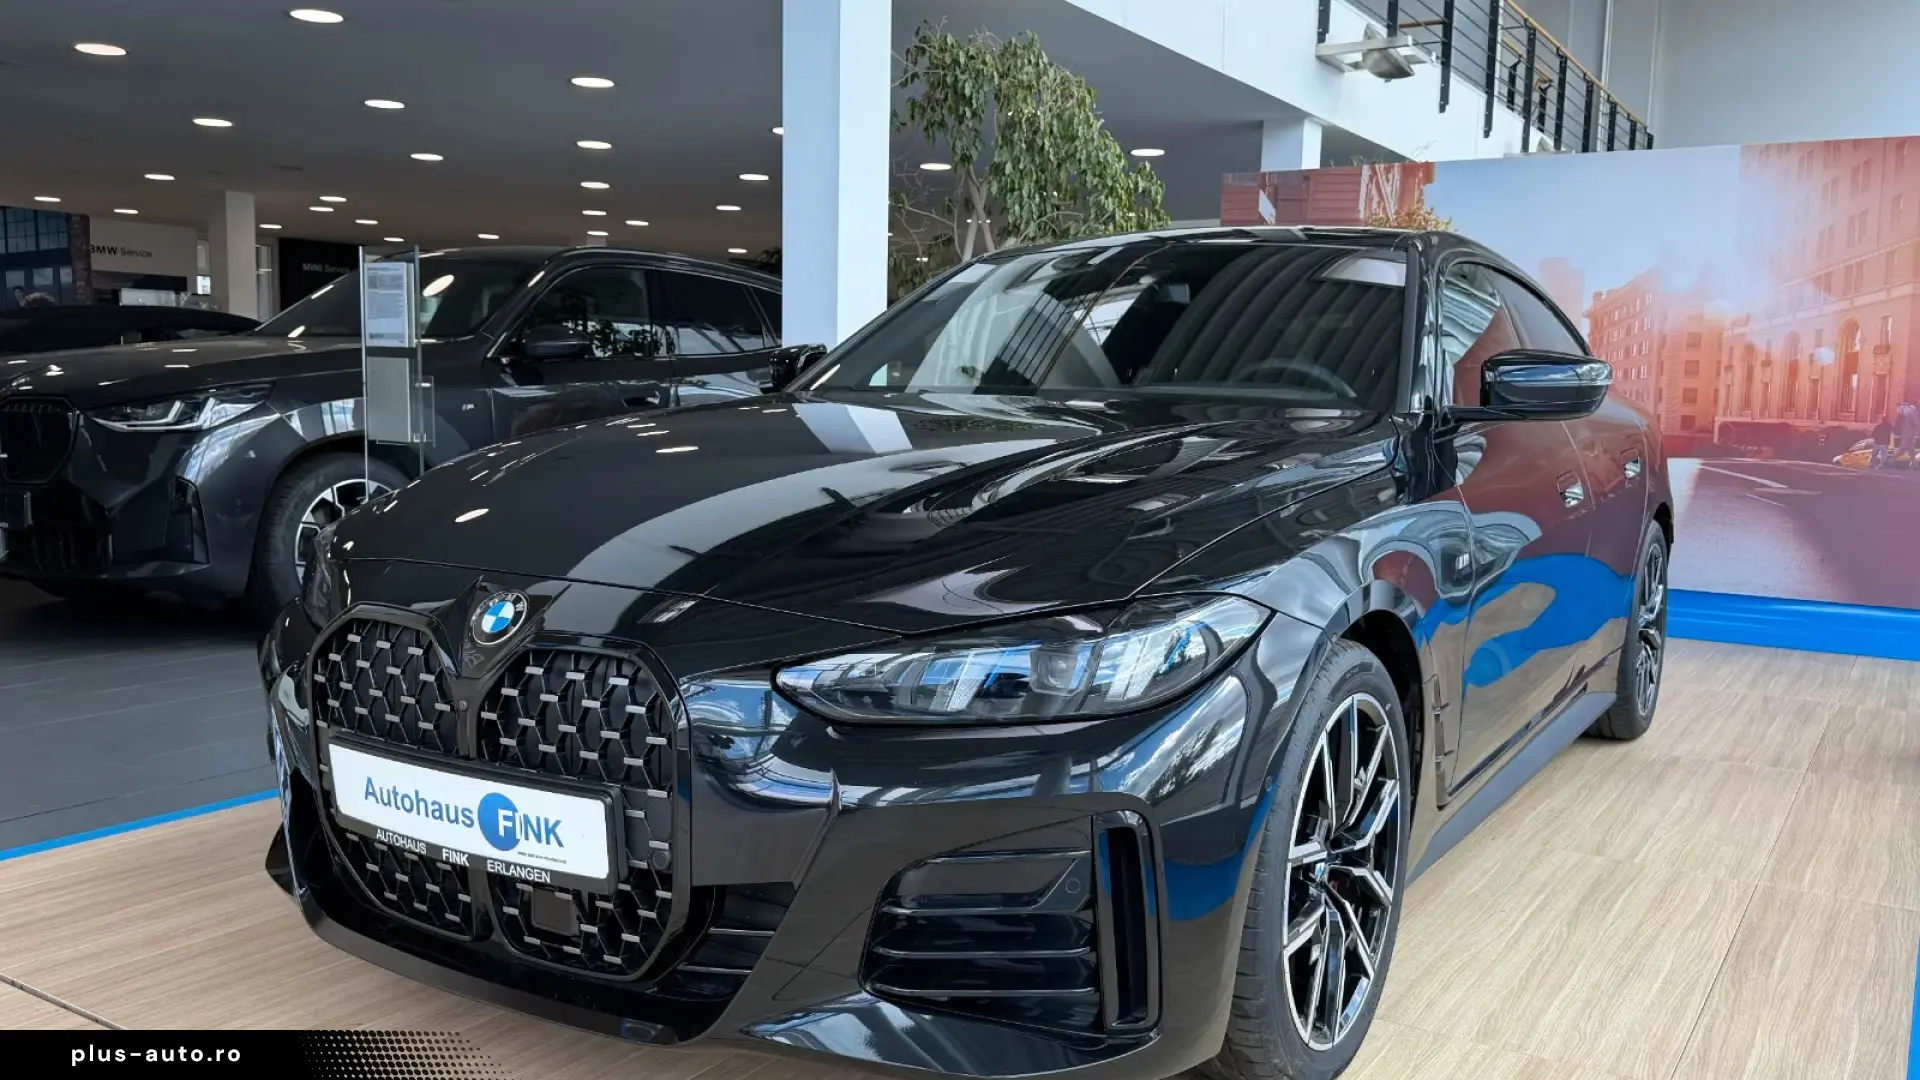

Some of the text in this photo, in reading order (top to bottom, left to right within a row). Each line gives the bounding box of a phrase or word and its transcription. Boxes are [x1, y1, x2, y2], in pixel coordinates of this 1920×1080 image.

[120, 246, 153, 258] Service
[364, 776, 564, 848] Autohaus FINK
[376, 828, 551, 884] AUTOHAUS FINK ERLANGEN
